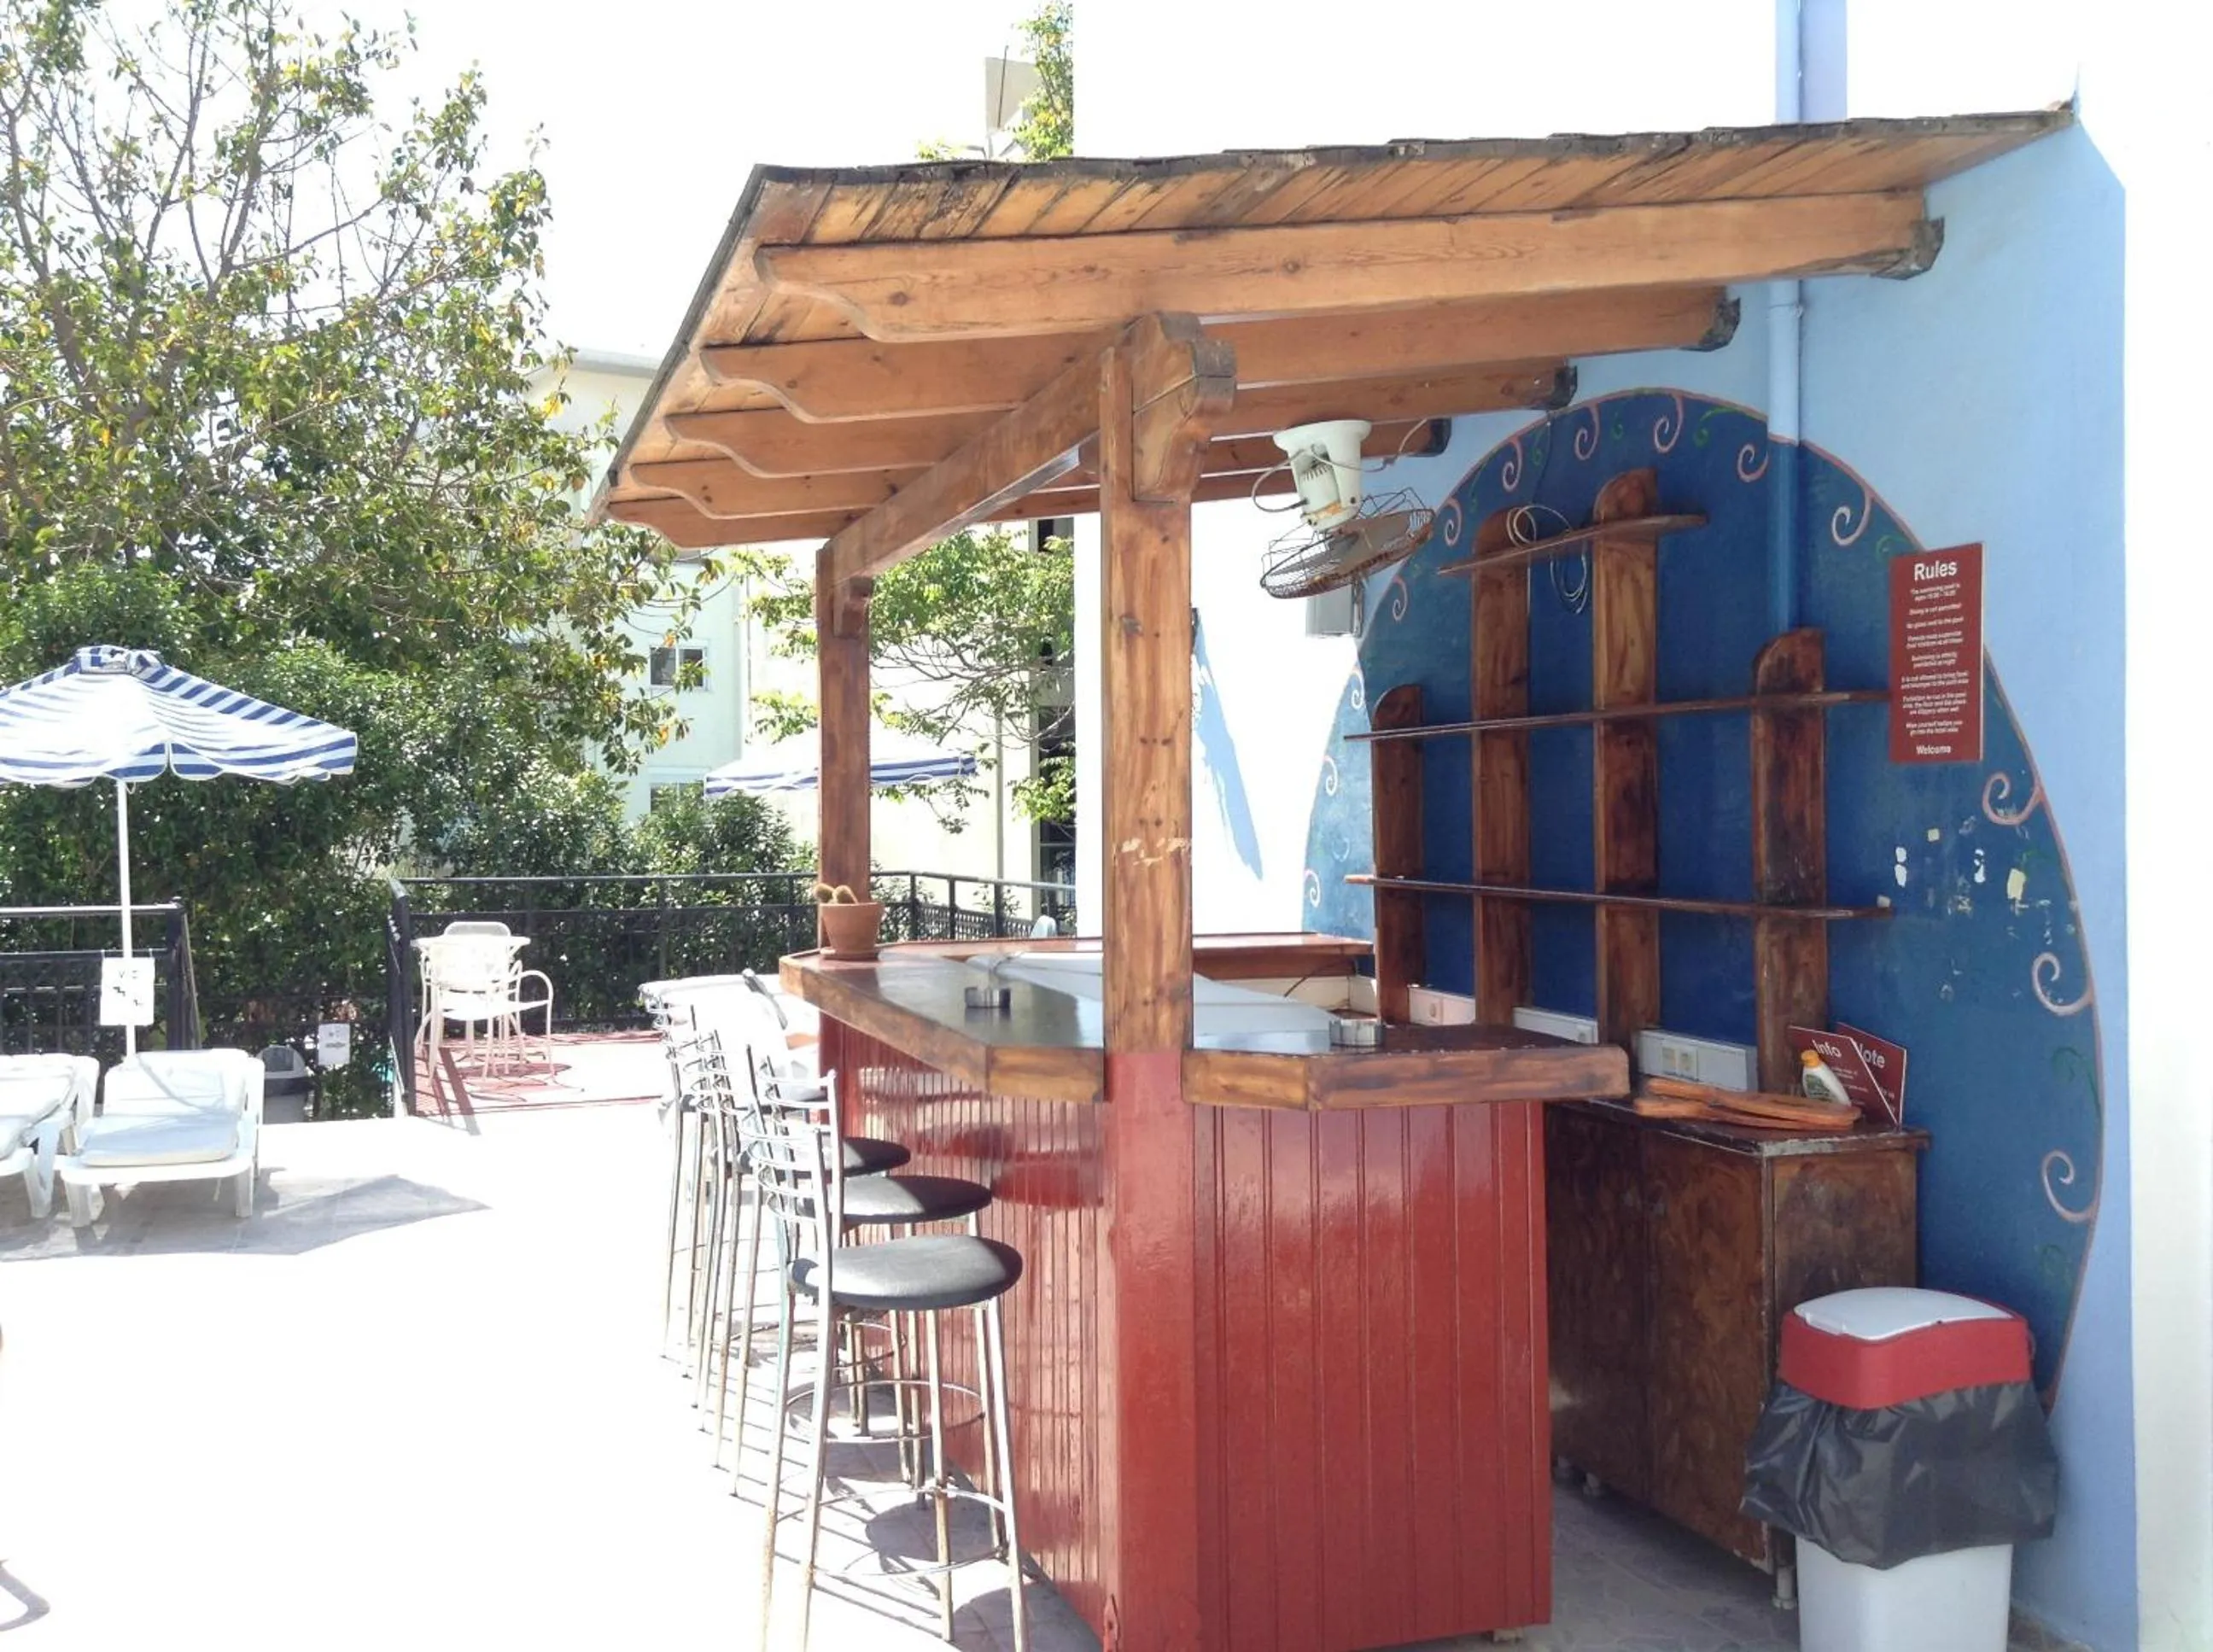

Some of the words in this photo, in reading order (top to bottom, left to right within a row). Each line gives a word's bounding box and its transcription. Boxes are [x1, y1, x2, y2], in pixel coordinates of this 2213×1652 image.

[1914, 560, 1957, 581] Rules
[1916, 745, 1951, 755] Welcome
[1812, 1039, 1842, 1058] Info
[1860, 1042, 1885, 1069] ote
